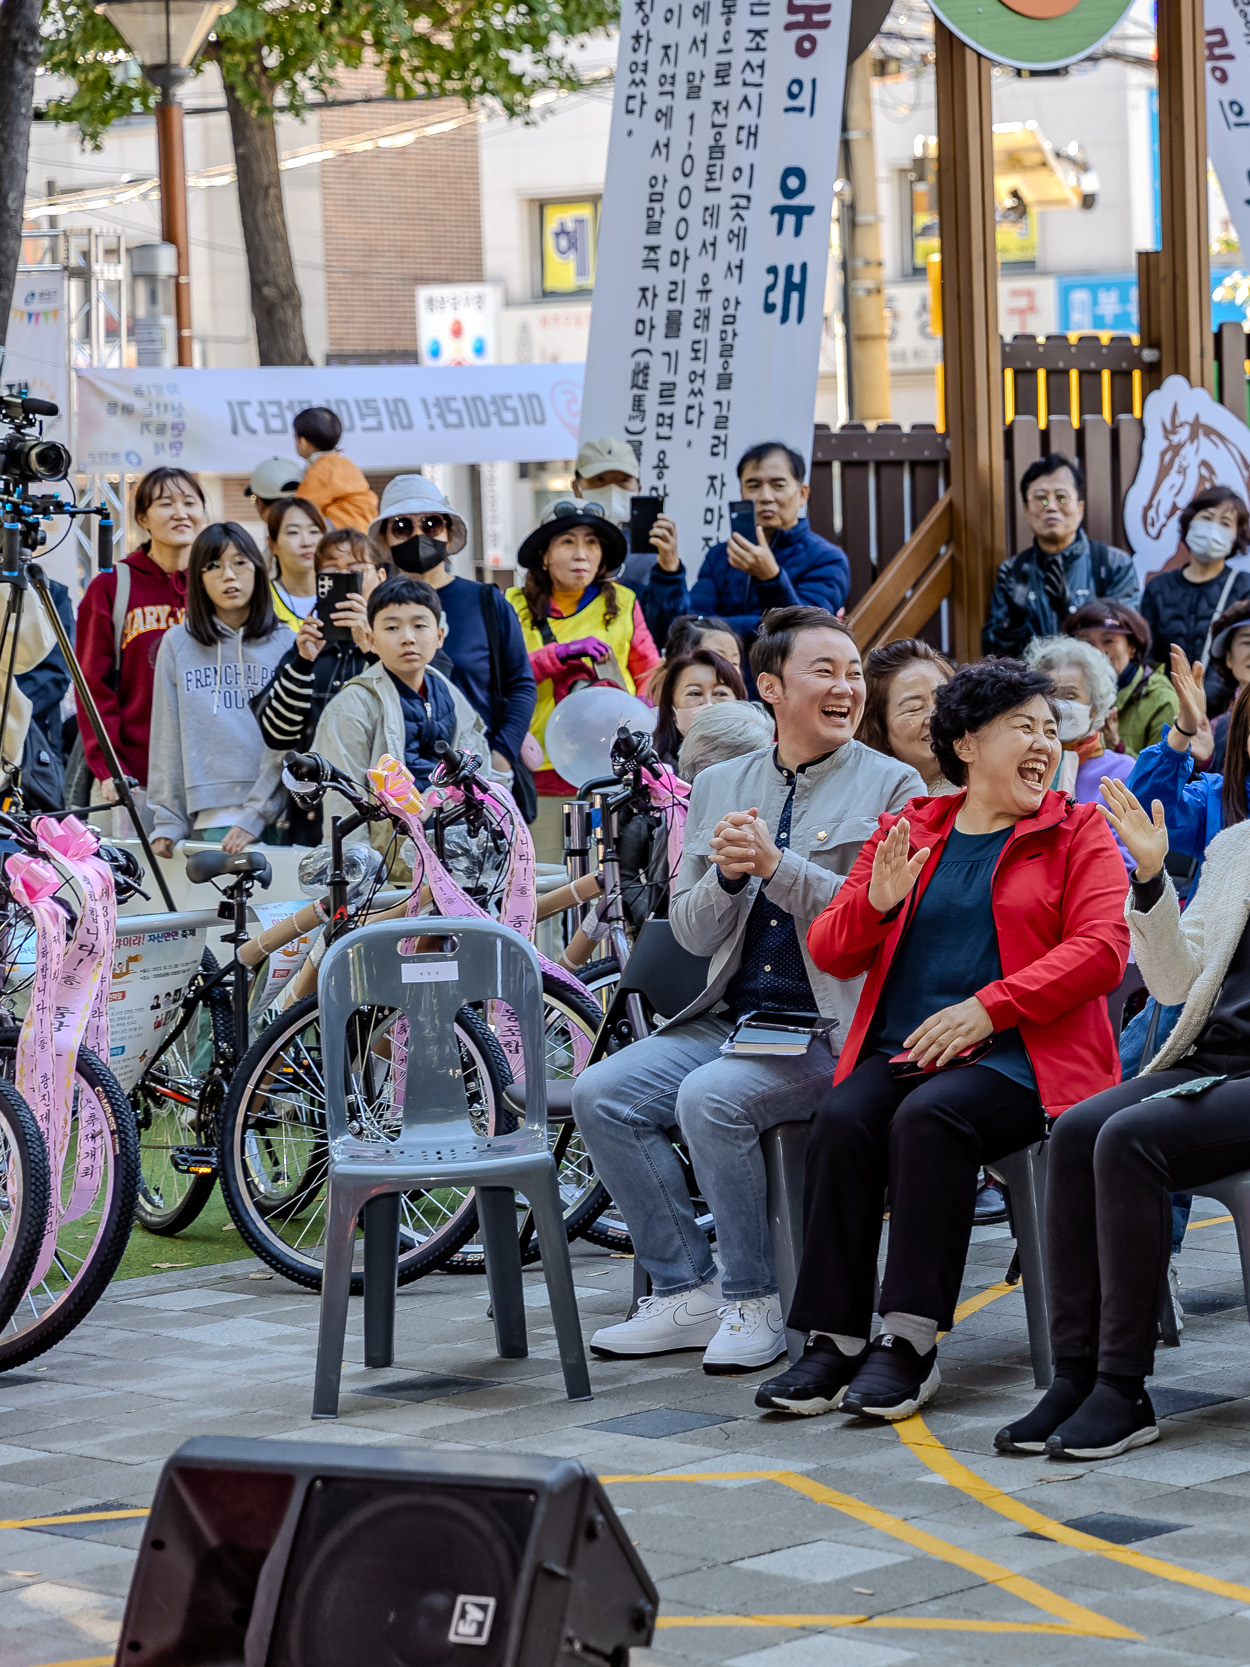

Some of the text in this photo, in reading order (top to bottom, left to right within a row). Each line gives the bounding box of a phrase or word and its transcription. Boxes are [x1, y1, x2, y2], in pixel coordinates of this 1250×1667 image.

[664, 4, 683, 28] 이
[651, 42, 679, 162] 지역에서
[686, 71, 706, 100] 말
[735, 28, 769, 151] 조선시대
[704, 100, 729, 193] 전음된
[645, 174, 667, 236] 암말
[698, 203, 720, 262] 데서
[724, 163, 755, 284] 이곳에서
[642, 244, 661, 273] 즉
[762, 166, 816, 325] 유래
[716, 296, 741, 391] 암말을
[655, 349, 679, 441] 기르면
[709, 399, 731, 461] 길러
[147, 930, 180, 943] 자신만만
[181, 928, 197, 939] 축제
[94, 1086, 117, 1132] COMPASS
